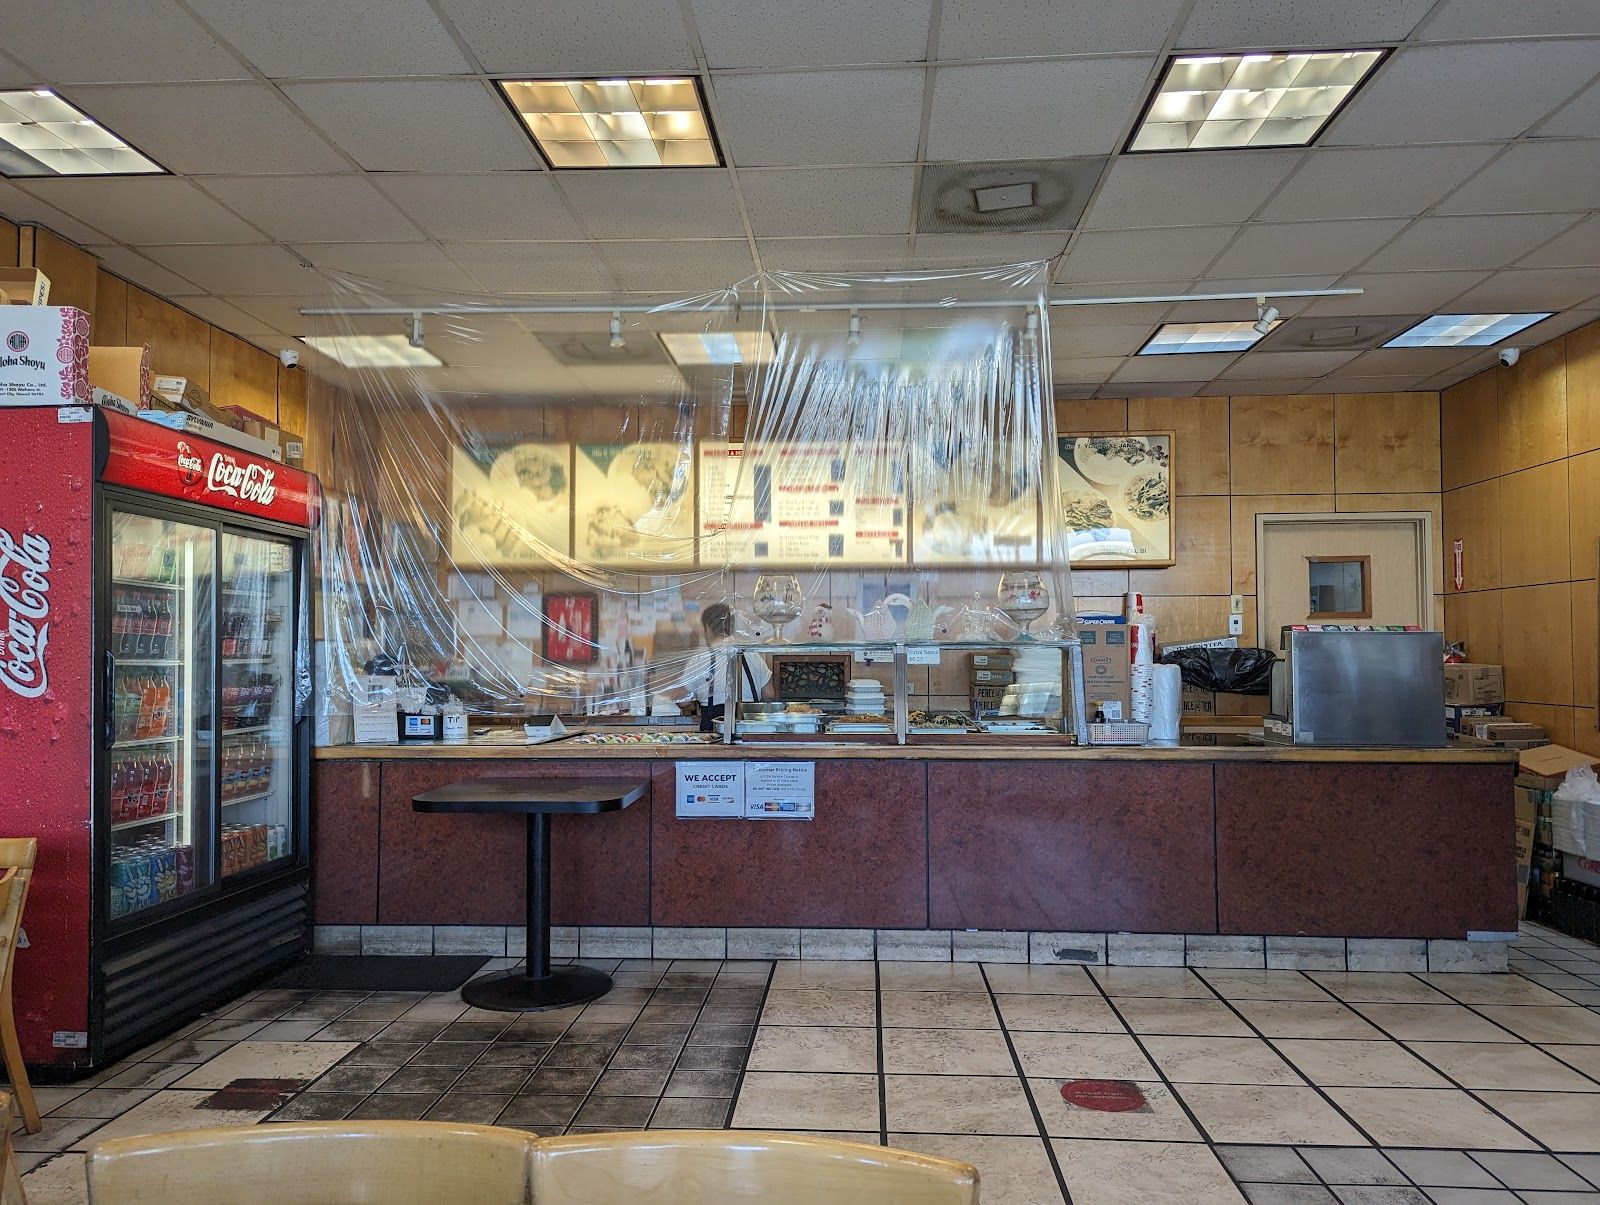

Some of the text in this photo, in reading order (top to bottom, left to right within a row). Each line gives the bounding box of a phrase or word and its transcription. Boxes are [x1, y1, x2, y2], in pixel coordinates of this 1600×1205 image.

[20, 356, 46, 371] Shoyu
[186, 414, 214, 429] SYLVANIA
[207, 452, 276, 506] Coca-Cola
[0, 527, 51, 698] Coca-Cola
[684, 774, 737, 782] WE ACCEPT
